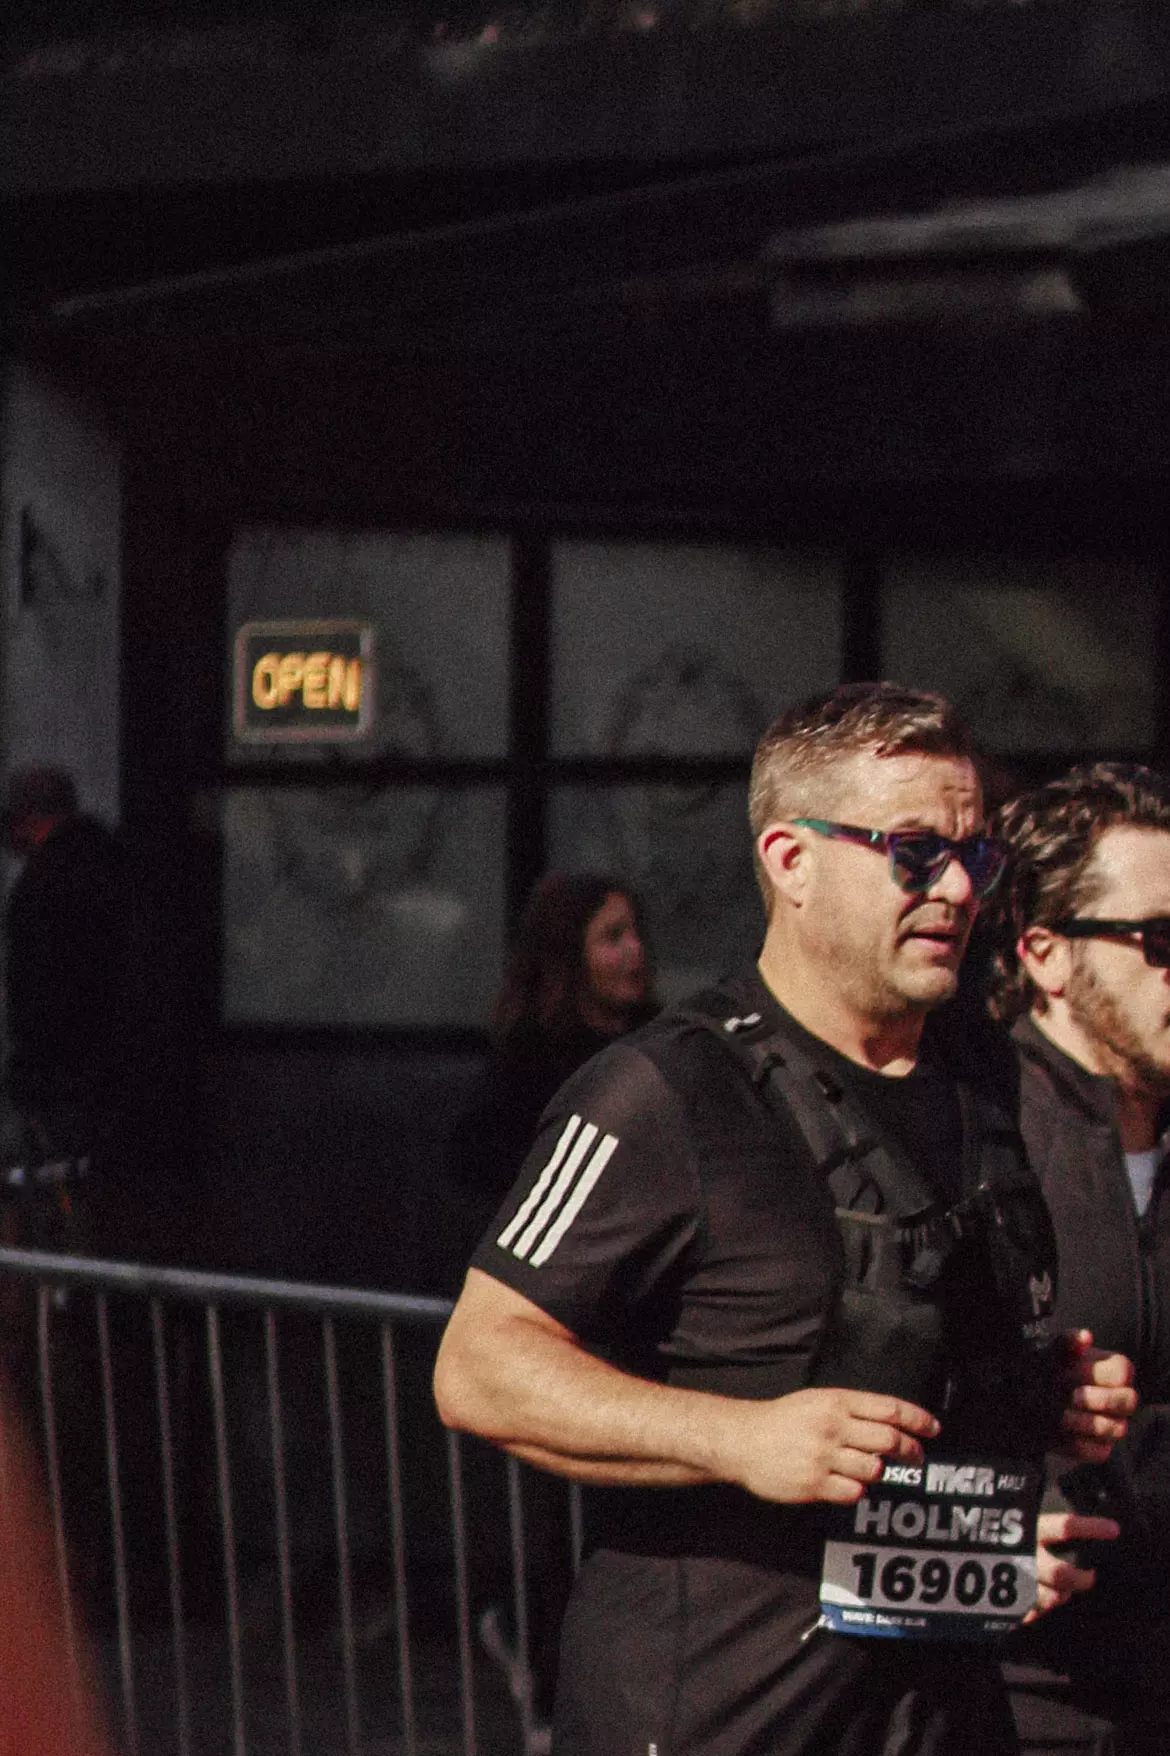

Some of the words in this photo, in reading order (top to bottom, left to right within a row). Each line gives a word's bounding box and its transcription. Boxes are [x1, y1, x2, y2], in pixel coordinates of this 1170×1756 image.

[252, 652, 360, 711] OPEN
[853, 1497, 1024, 1547] HOLMES
[851, 1551, 1019, 1609] 16908
